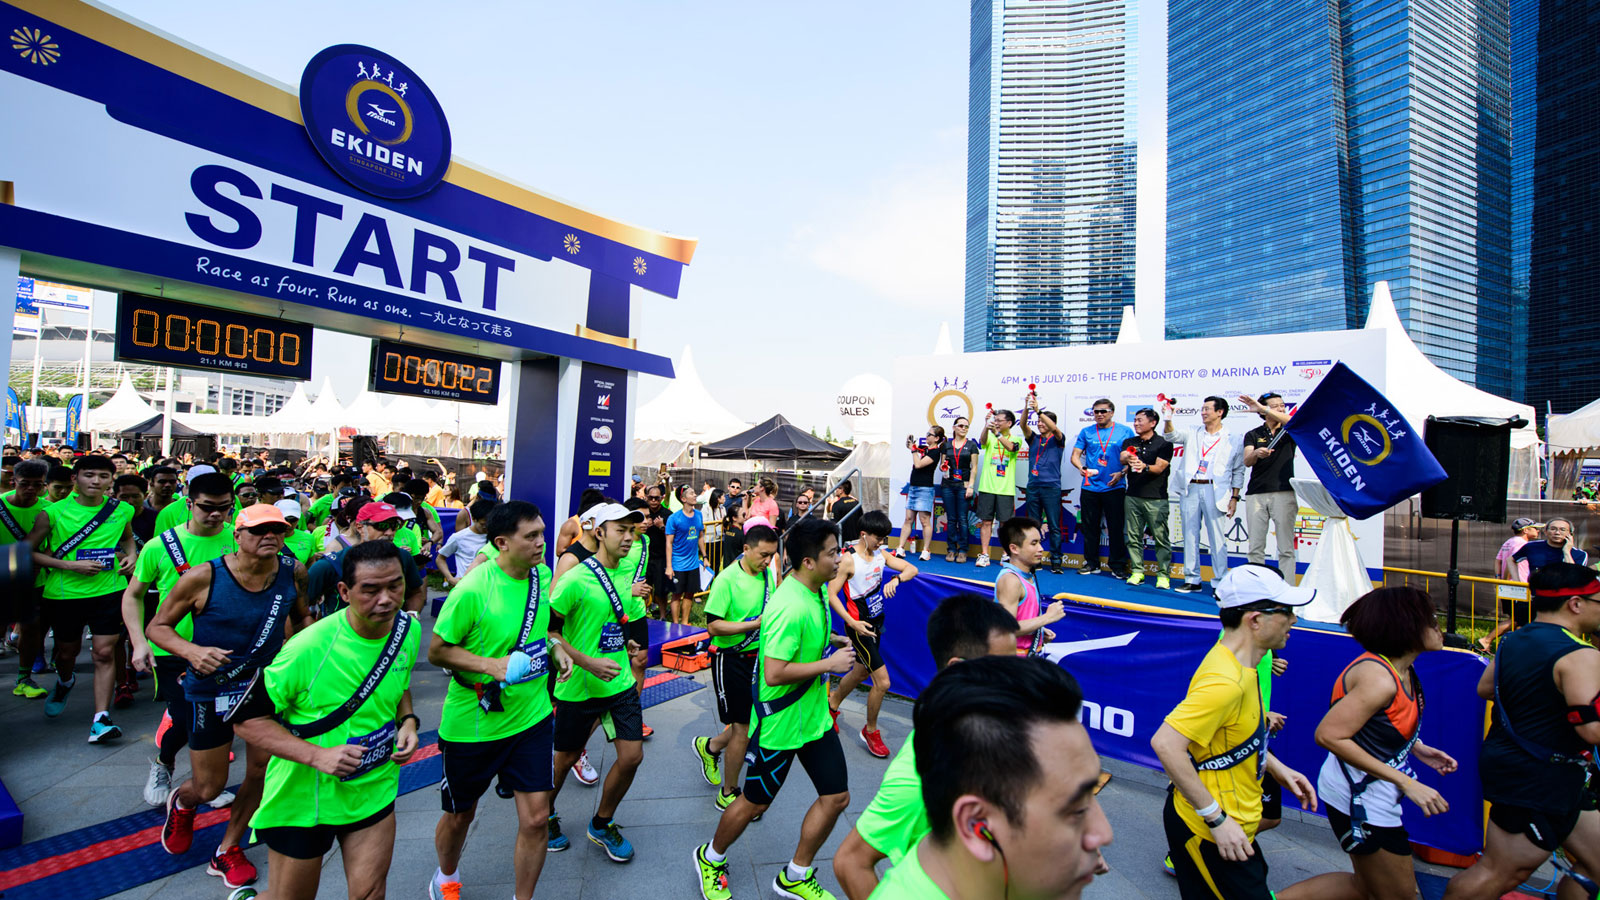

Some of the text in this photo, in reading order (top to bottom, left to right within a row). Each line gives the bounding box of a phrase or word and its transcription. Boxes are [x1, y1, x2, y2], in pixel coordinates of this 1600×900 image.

[331, 128, 423, 176] EKIDEN
[349, 155, 386, 173] SINGAPORE
[184, 164, 515, 312] START
[196, 256, 513, 338] Race as four. Run as one. 一丸となって走る
[132, 308, 300, 366] 00:00:00
[200, 357, 216, 365] 21.1
[218, 359, 232, 367] KM
[384, 352, 493, 394] 00:00:22
[1001, 376, 1020, 384] 4PM
[1030, 374, 1040, 384] 16
[1042, 374, 1065, 383] JULY
[1066, 373, 1088, 383] 2016
[1098, 372, 1118, 381] THE
[1120, 368, 1195, 381] PROMONTORY
[1197, 368, 1208, 379] @
[1211, 366, 1260, 378] MARINA
[1263, 365, 1287, 376] BAY
[836, 395, 875, 405] COUPON
[840, 407, 870, 417] SALES
[1318, 427, 1367, 492] EKIDEN
[61, 520, 99, 552] EKIDEN 2016
[594, 566, 614, 593] EKIDEN
[610, 591, 622, 612] 2016
[255, 617, 276, 648] EKIDEN
[269, 594, 283, 616] 2016
[519, 610, 534, 648] MIZUNO
[528, 576, 538, 609] EKIDEN
[358, 618, 407, 699] MIZUNO EKIDEN
[530, 657, 545, 672] 88-
[1198, 738, 1261, 771] KIDEN 2016
